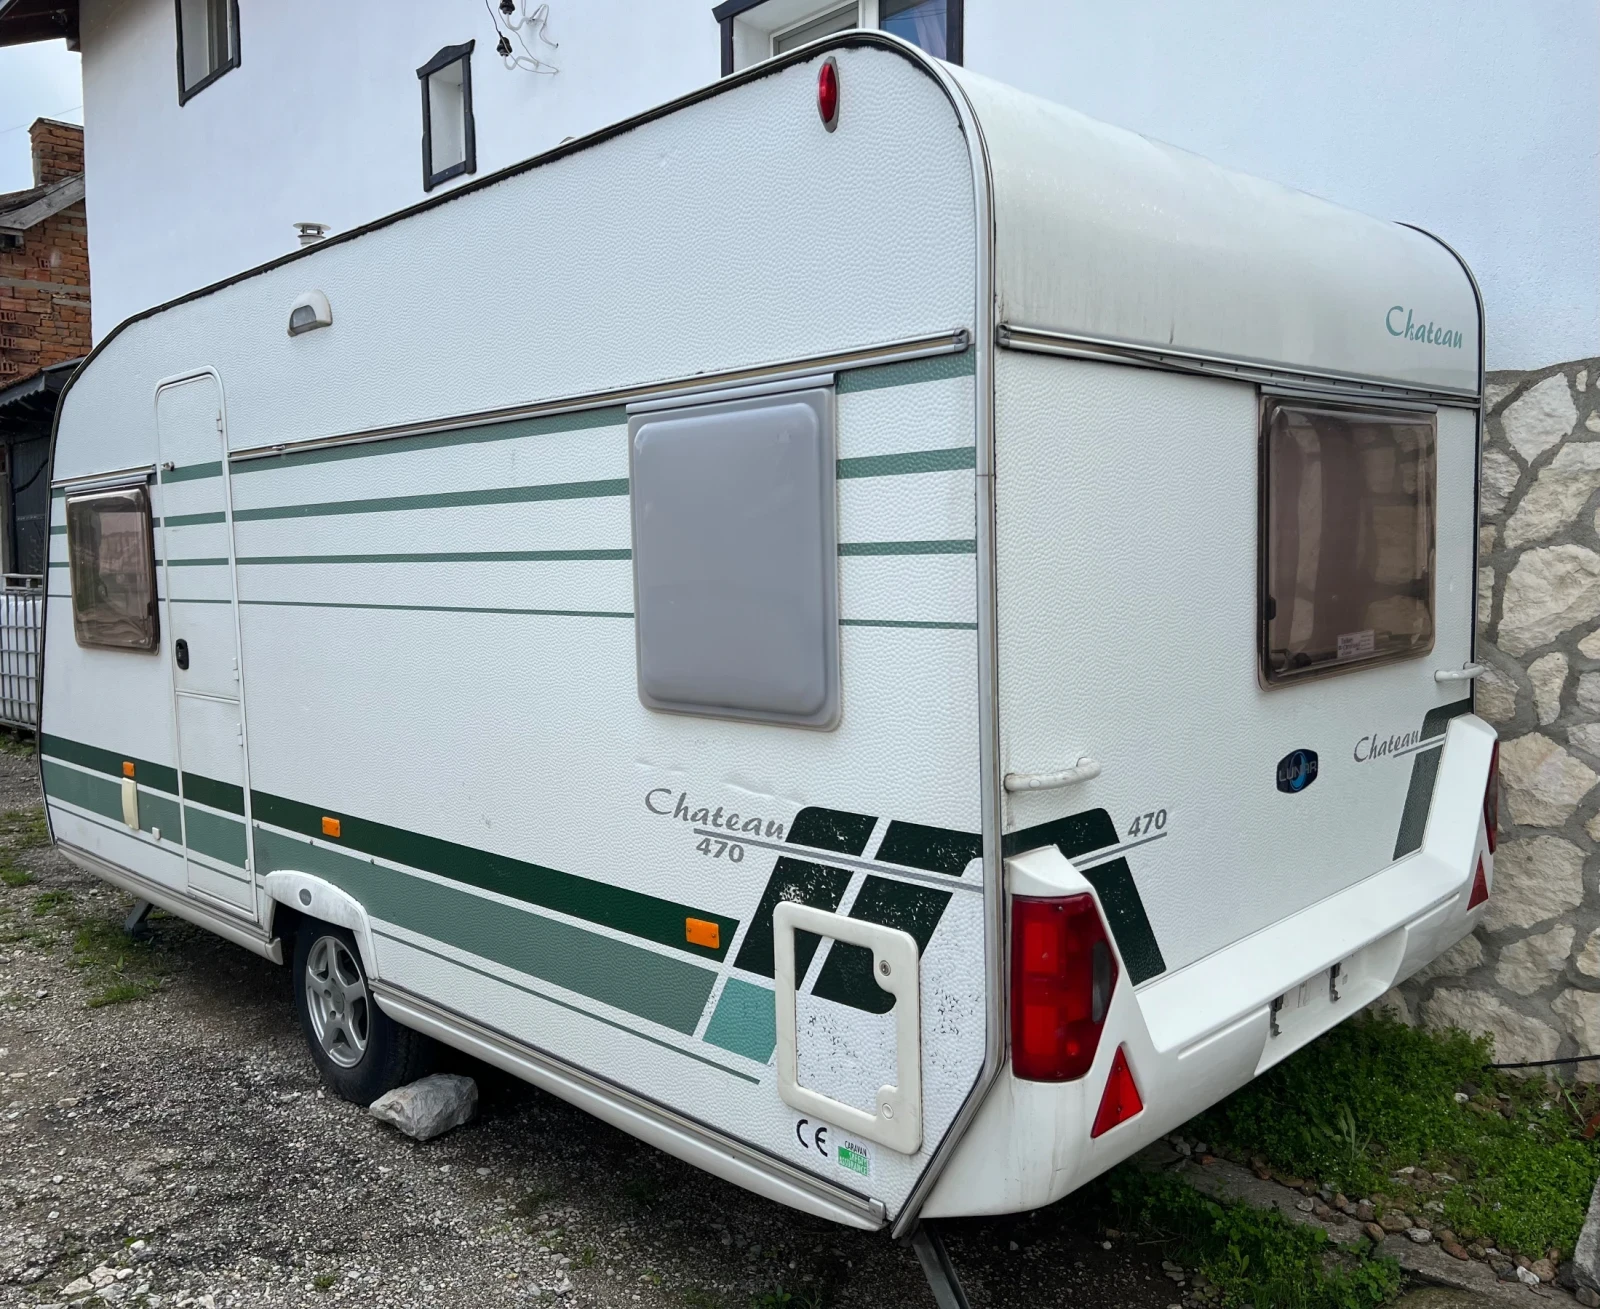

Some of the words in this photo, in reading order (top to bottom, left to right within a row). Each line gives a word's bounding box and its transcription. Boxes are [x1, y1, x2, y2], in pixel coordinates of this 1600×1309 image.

[1385, 305, 1463, 349] Chateau
[1353, 730, 1421, 763] Chateau
[1278, 760, 1317, 782] LUNAR
[644, 788, 785, 840] Chateau
[1127, 808, 1168, 837] 470
[695, 837, 745, 863] 470
[796, 1118, 828, 1157] CE
[844, 1140, 867, 1157] CARAVAN
